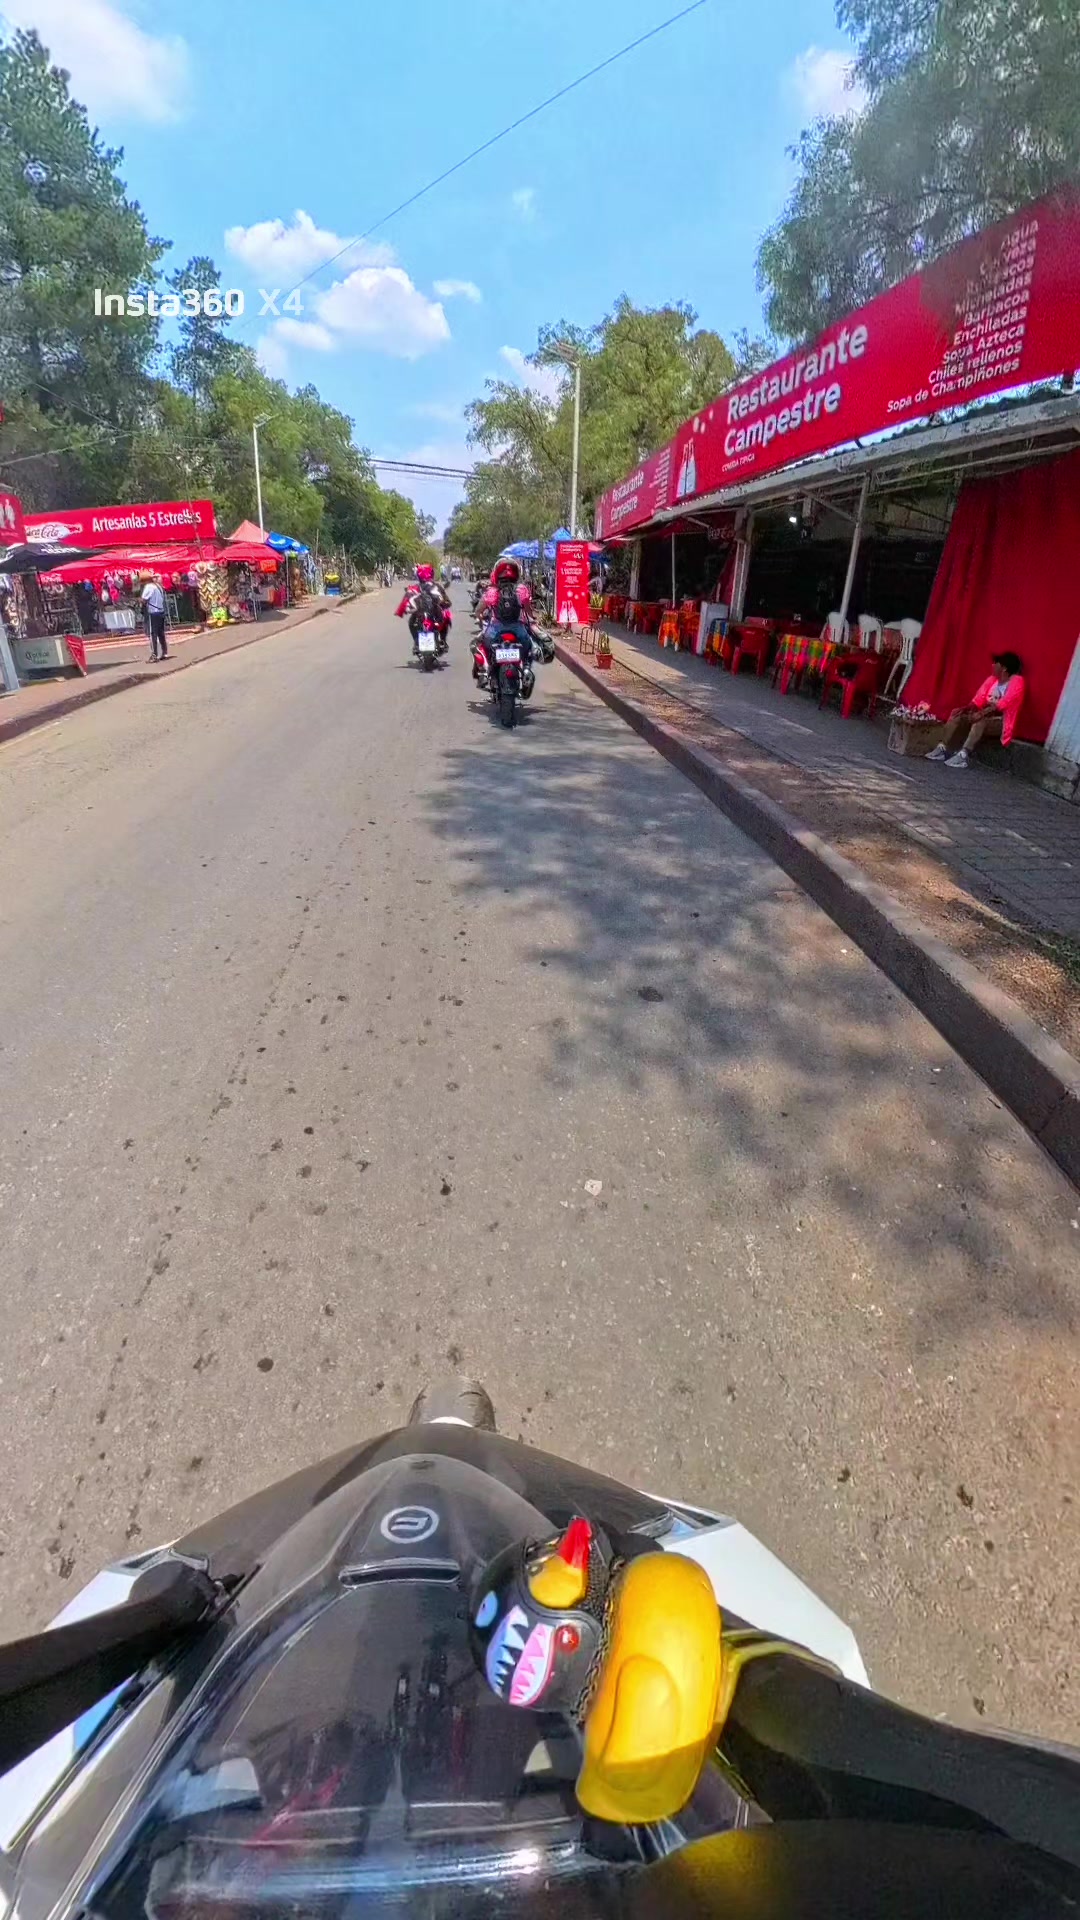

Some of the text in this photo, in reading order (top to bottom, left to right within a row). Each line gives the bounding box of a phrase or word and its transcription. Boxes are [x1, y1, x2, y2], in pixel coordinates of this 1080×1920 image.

[979, 237, 1037, 275] Cveza
[953, 306, 1028, 346] Enchiladas
[963, 289, 1030, 327] Barbacoa
[928, 340, 1023, 384] Chiles rellenos
[942, 323, 1025, 365] Sopa Azteca
[727, 324, 869, 425] Restaurante
[724, 382, 841, 457] Campestre
[886, 395, 913, 413] Sopa
[914, 389, 929, 403] de
[92, 511, 147, 533] Artesanías
[149, 511, 156, 527] 5
